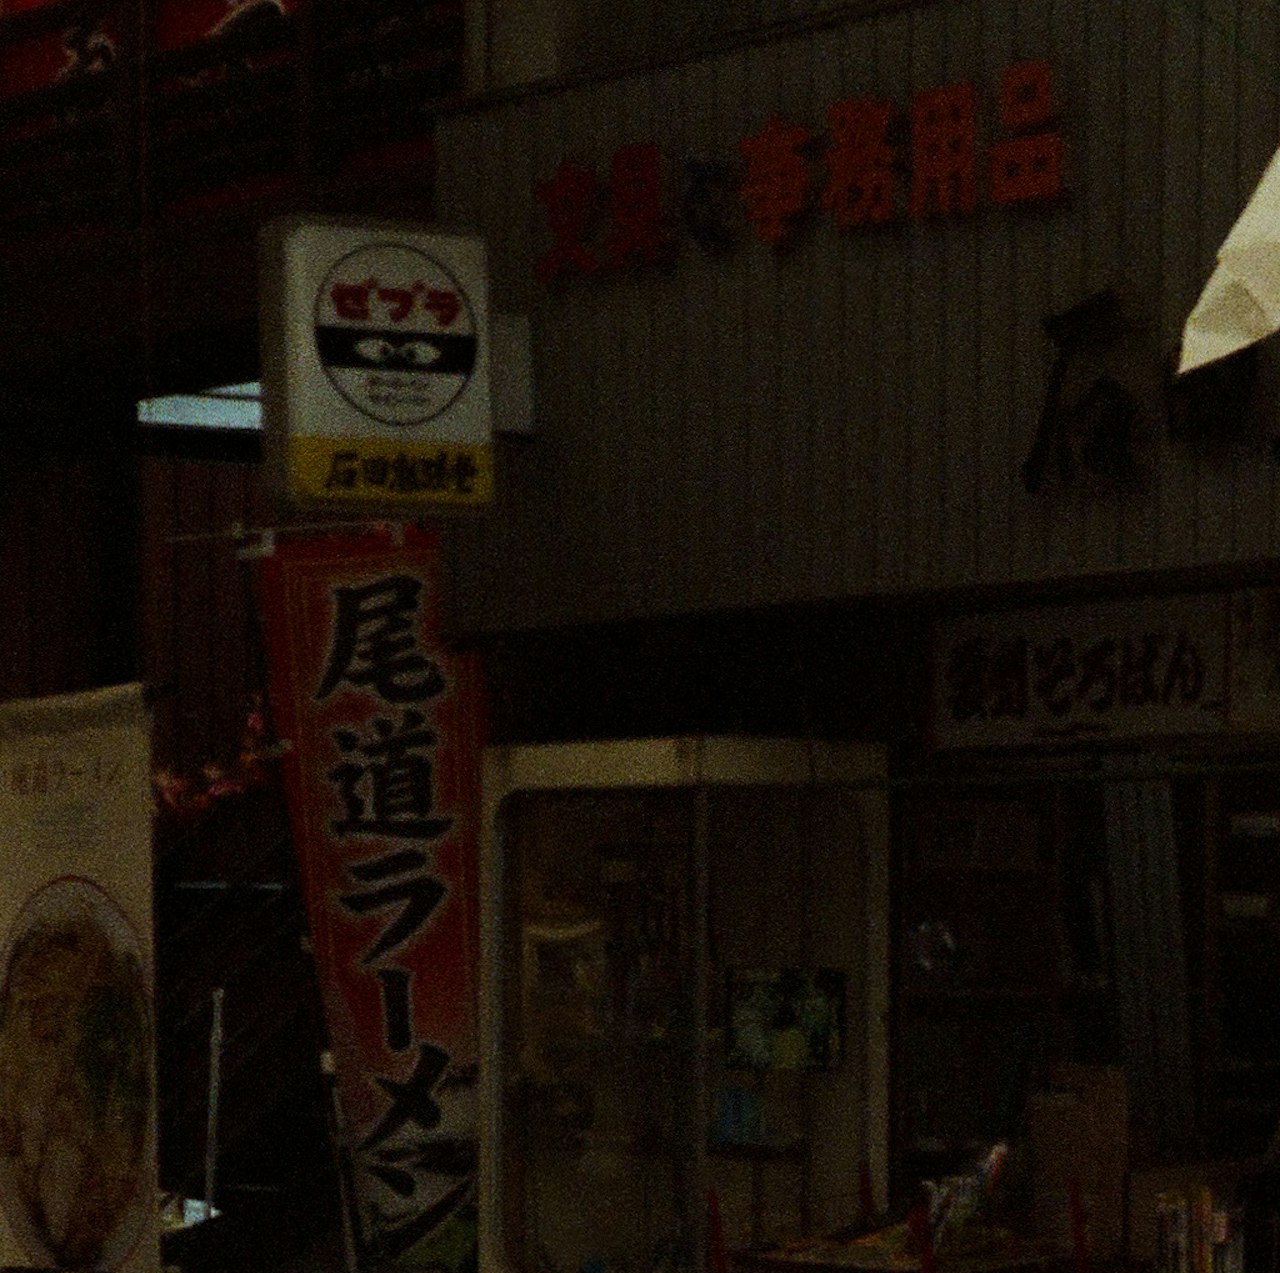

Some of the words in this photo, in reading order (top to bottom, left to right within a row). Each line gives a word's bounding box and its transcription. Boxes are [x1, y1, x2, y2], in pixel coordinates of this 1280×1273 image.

[331, 277, 461, 327] ゼブラ
[316, 572, 478, 1260] 尾道ラーメン
